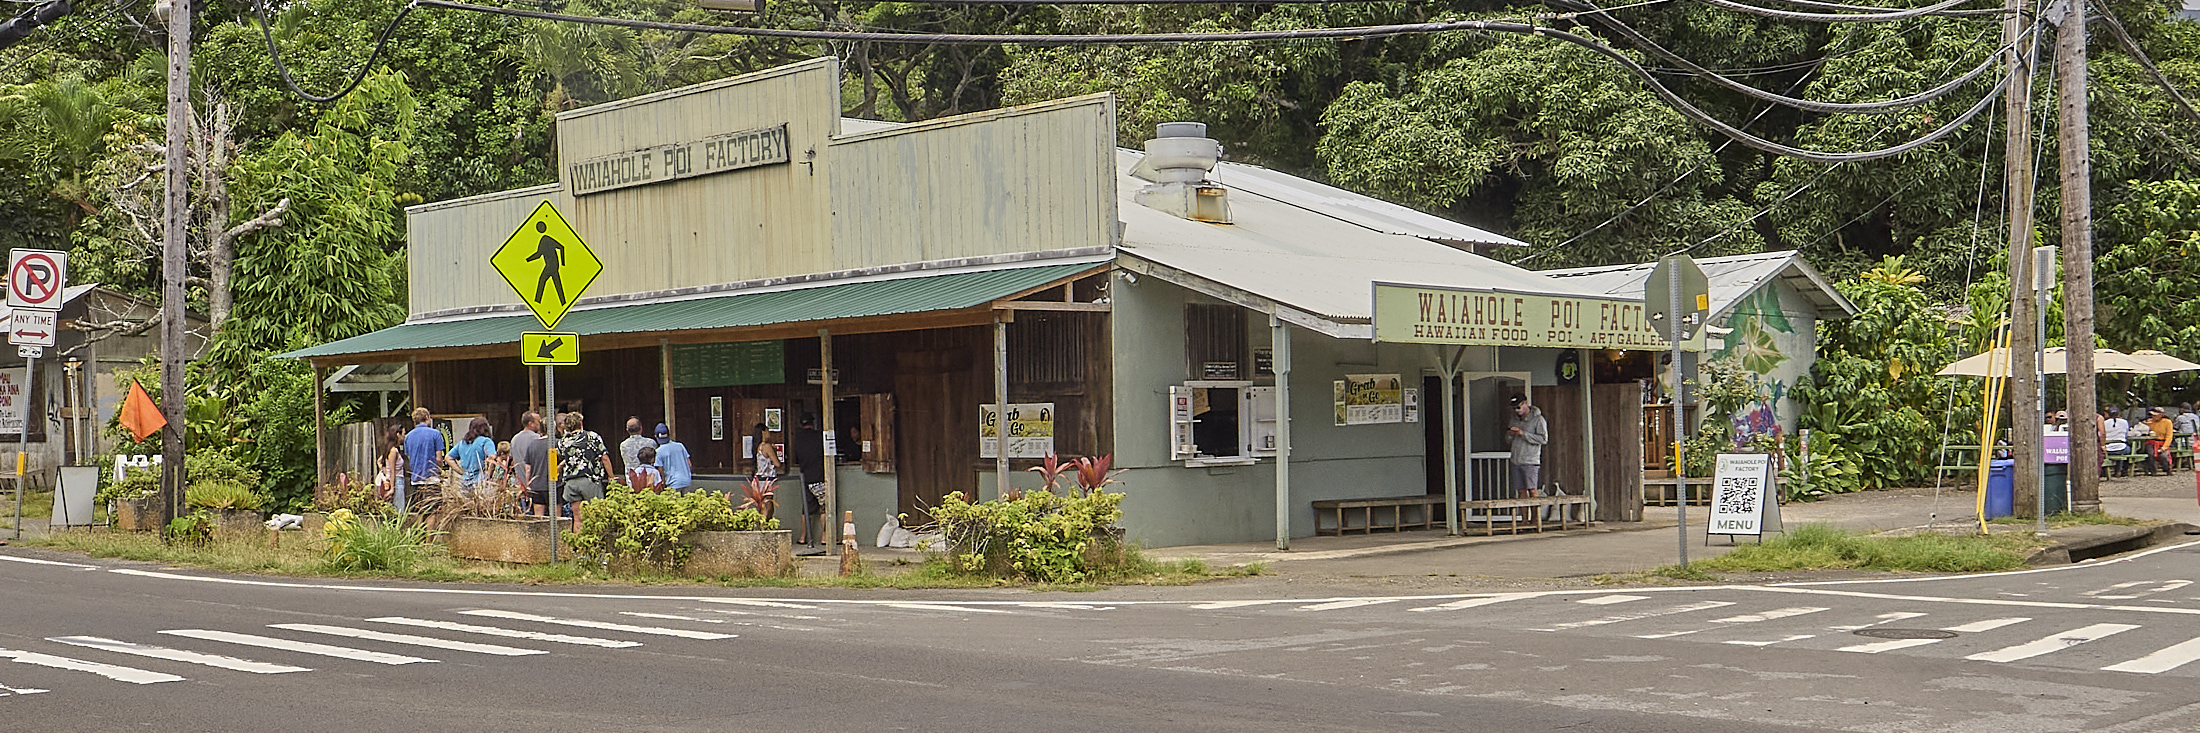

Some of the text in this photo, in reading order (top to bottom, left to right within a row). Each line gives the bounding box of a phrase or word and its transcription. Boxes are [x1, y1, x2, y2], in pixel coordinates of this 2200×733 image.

[573, 128, 783, 191] WAIAHOLE POI FACTORY
[14, 314, 52, 326] ANY TIME
[1418, 292, 1652, 333] WAIAHOLE POI FACTO
[1414, 325, 1485, 339] HAWAIIAN
[1492, 328, 1528, 342] FOOD
[1547, 330, 1572, 343] POI
[1617, 333, 1671, 347] GALLER
[1350, 378, 1376, 396] Grab
[1368, 390, 1379, 403] Go
[986, 408, 1020, 428] Gab
[1010, 422, 1024, 436] Go
[1717, 519, 1753, 530] MENU
